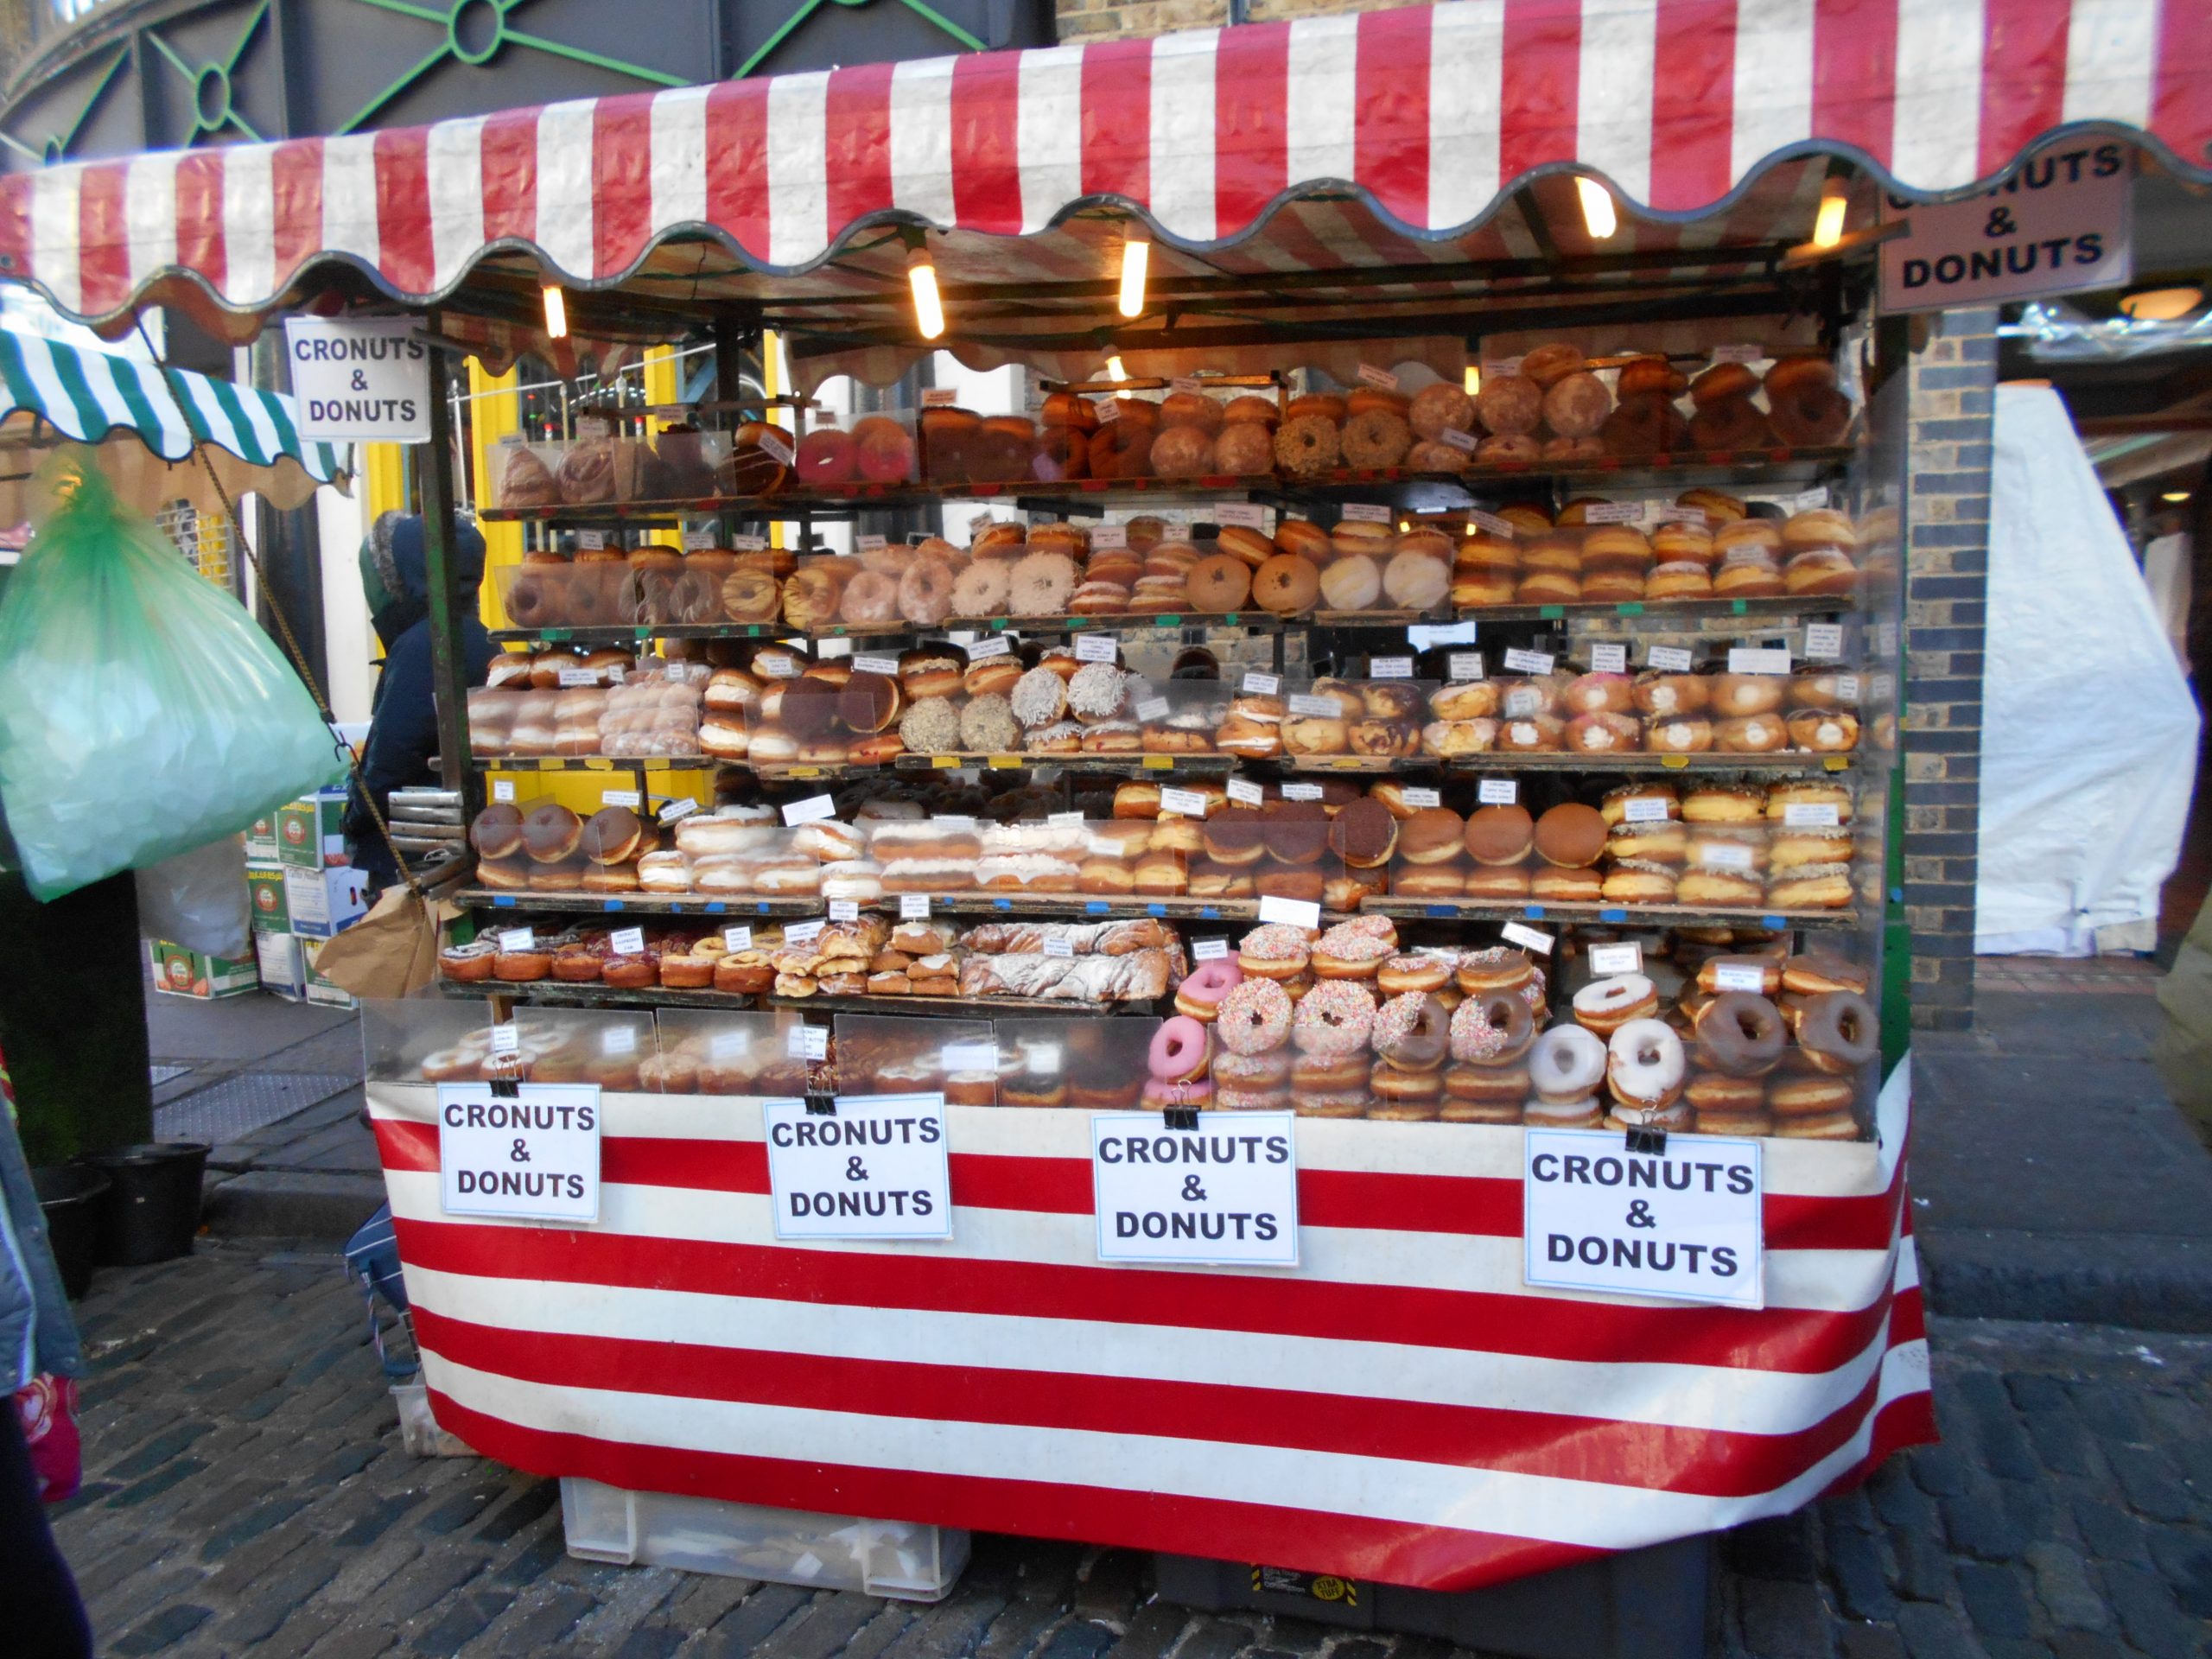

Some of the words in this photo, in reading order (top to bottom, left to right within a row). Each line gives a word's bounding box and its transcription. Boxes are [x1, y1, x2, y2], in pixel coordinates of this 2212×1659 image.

[1984, 206, 2018, 238] &
[1903, 232, 2103, 288] DONUTS
[295, 337, 424, 361] CRONUTS
[351, 369, 368, 391] &
[309, 399, 416, 422] DONUTS
[444, 1103, 594, 1131] CRONUTS
[772, 1117, 940, 1147] CRONUTS
[510, 1138, 531, 1162] &
[1098, 1136, 1289, 1164] CRONUTS
[845, 1155, 869, 1181] &
[1531, 1154, 1754, 1195] CRONUTS
[458, 1170, 584, 1198] DONUTS
[1181, 1174, 1208, 1202] &
[790, 1190, 933, 1217] DONUTS
[1625, 1199, 1656, 1229] &
[1116, 1211, 1278, 1241] DONUTS
[1548, 1234, 1738, 1277] DONUTS
